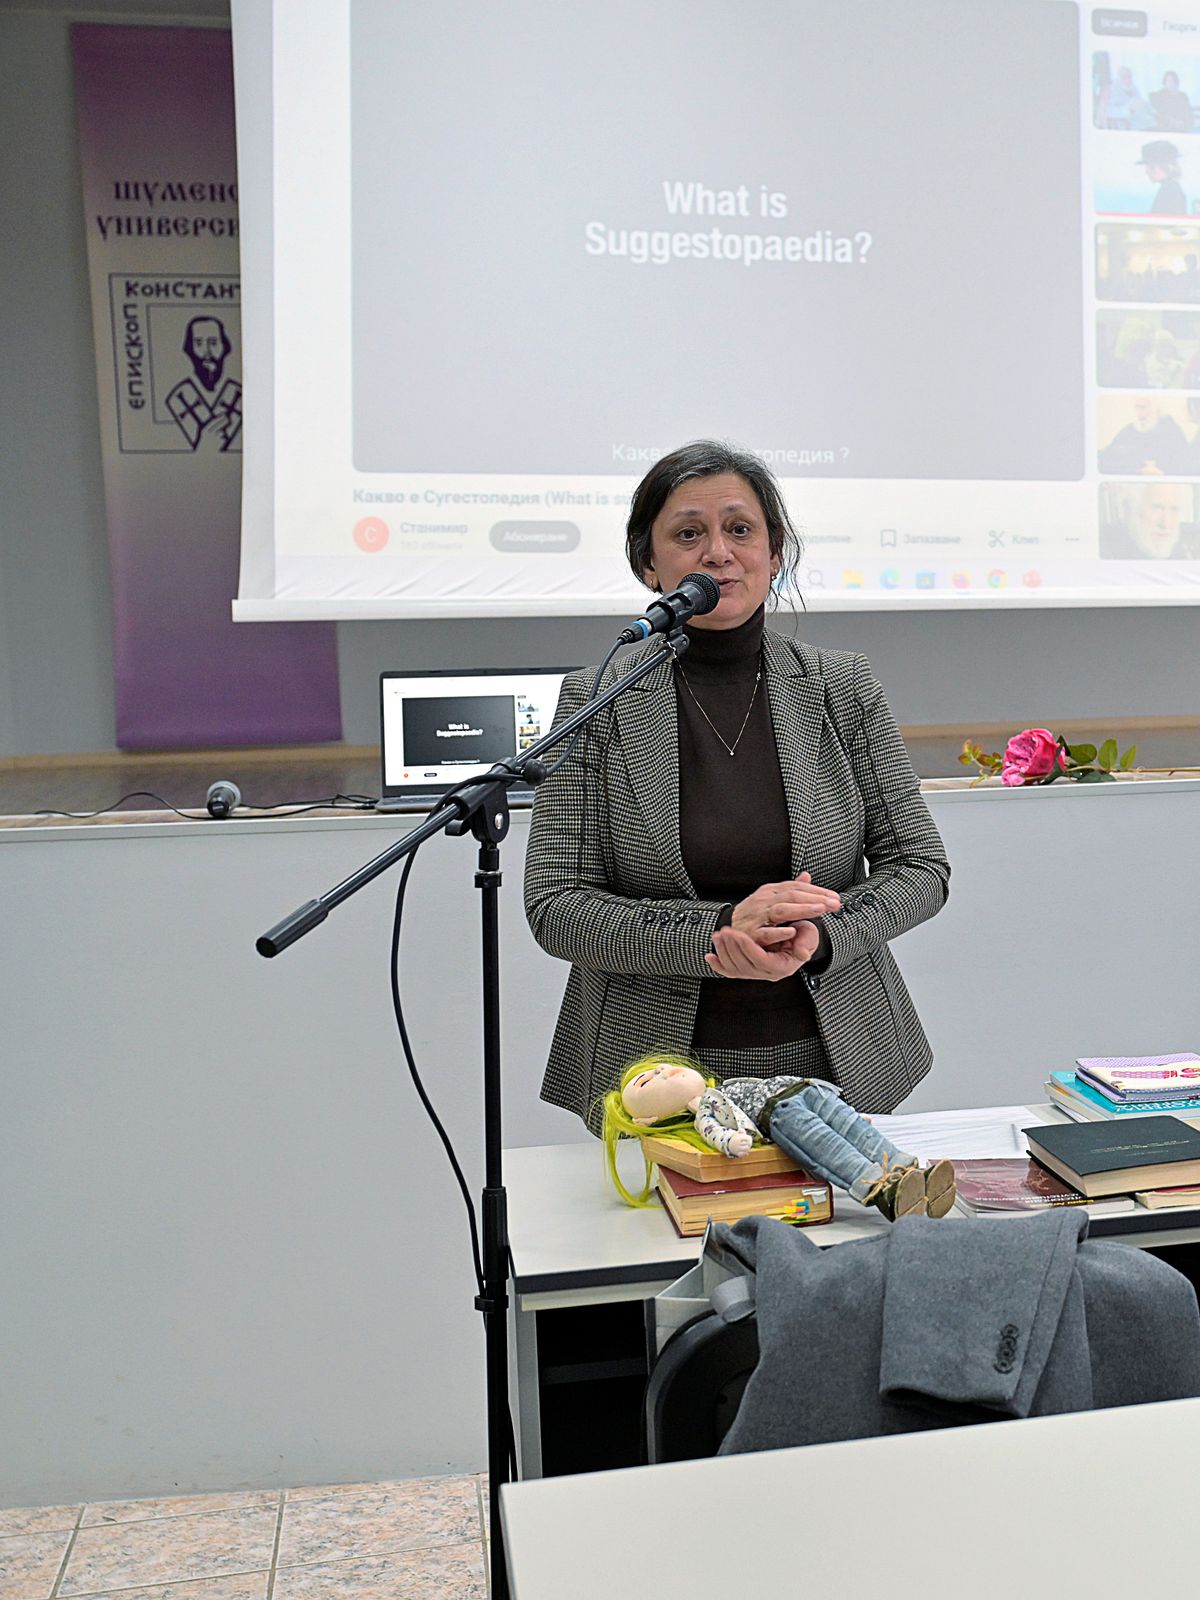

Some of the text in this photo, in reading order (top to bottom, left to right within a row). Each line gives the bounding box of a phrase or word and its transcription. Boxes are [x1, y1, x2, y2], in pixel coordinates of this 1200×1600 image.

[663, 181, 788, 218] What is
[585, 221, 873, 267] Suggestopaedia?
[353, 490, 405, 504] Какво
[410, 492, 419, 504] е
[424, 490, 540, 507] Сугестопедия
[545, 490, 591, 507] (What
